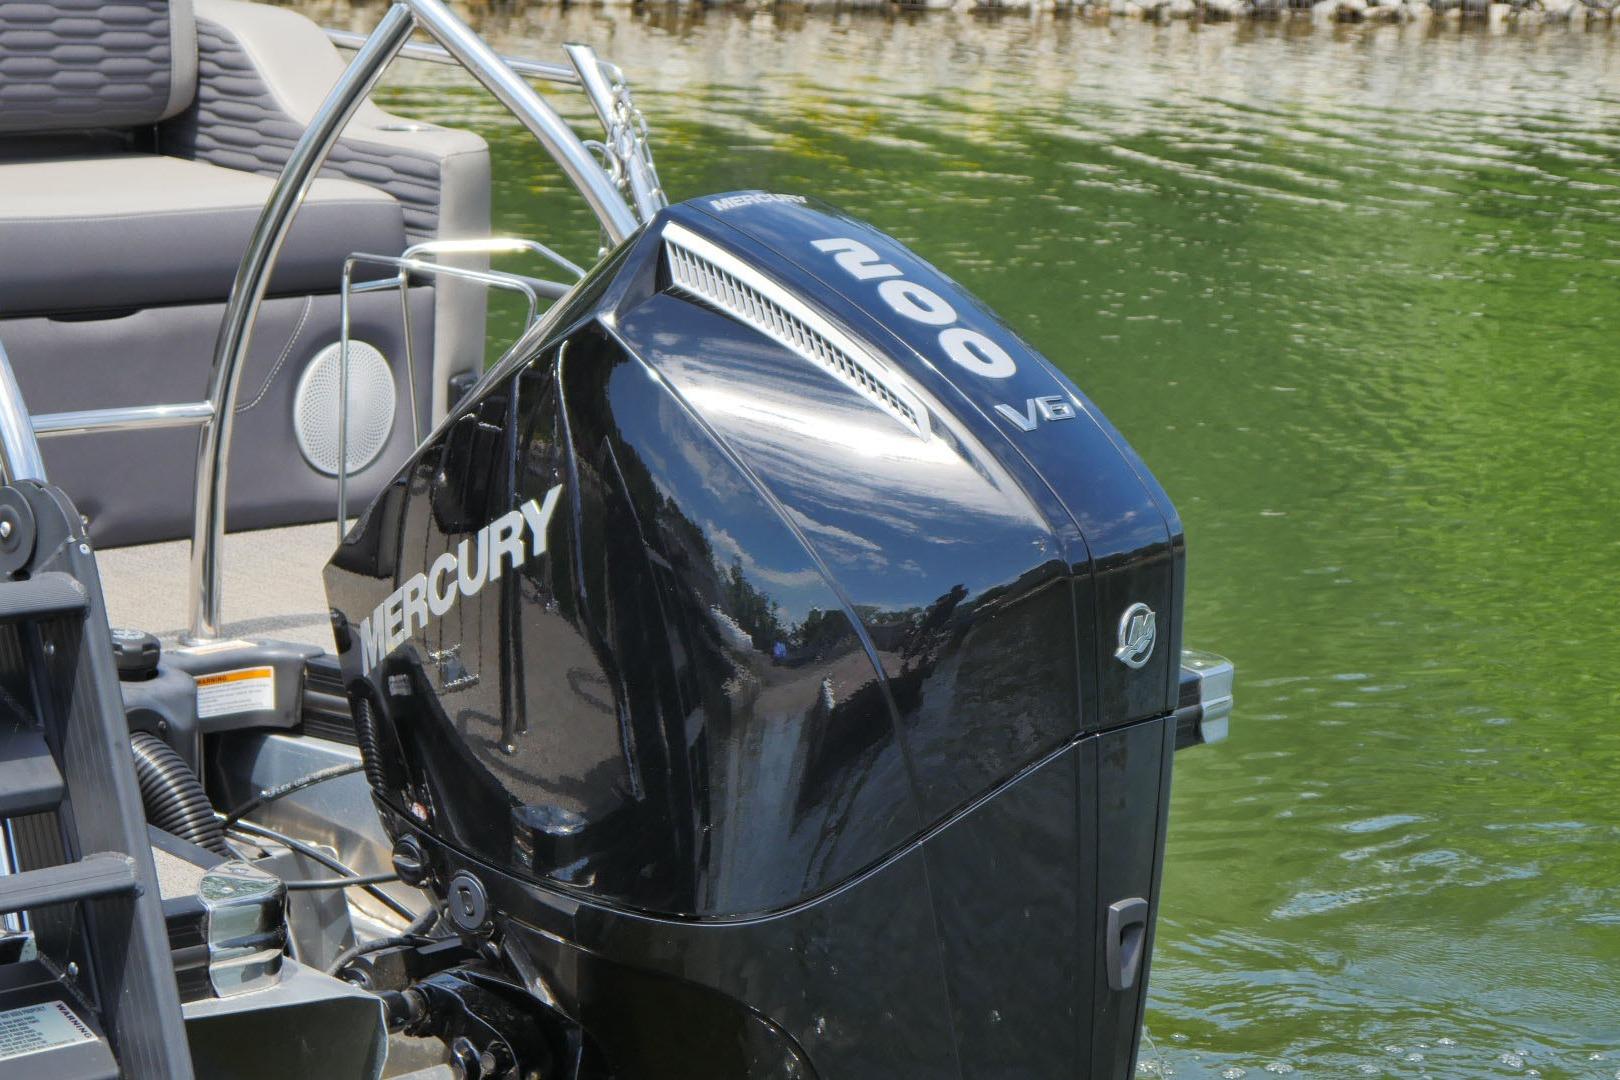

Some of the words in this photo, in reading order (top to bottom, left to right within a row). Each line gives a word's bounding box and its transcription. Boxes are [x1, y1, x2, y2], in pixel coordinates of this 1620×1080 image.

[810, 238, 1017, 379] 200
[994, 395, 1077, 432] V6
[359, 483, 563, 678] MERCURY
[56, 1003, 92, 1039] WARNING
